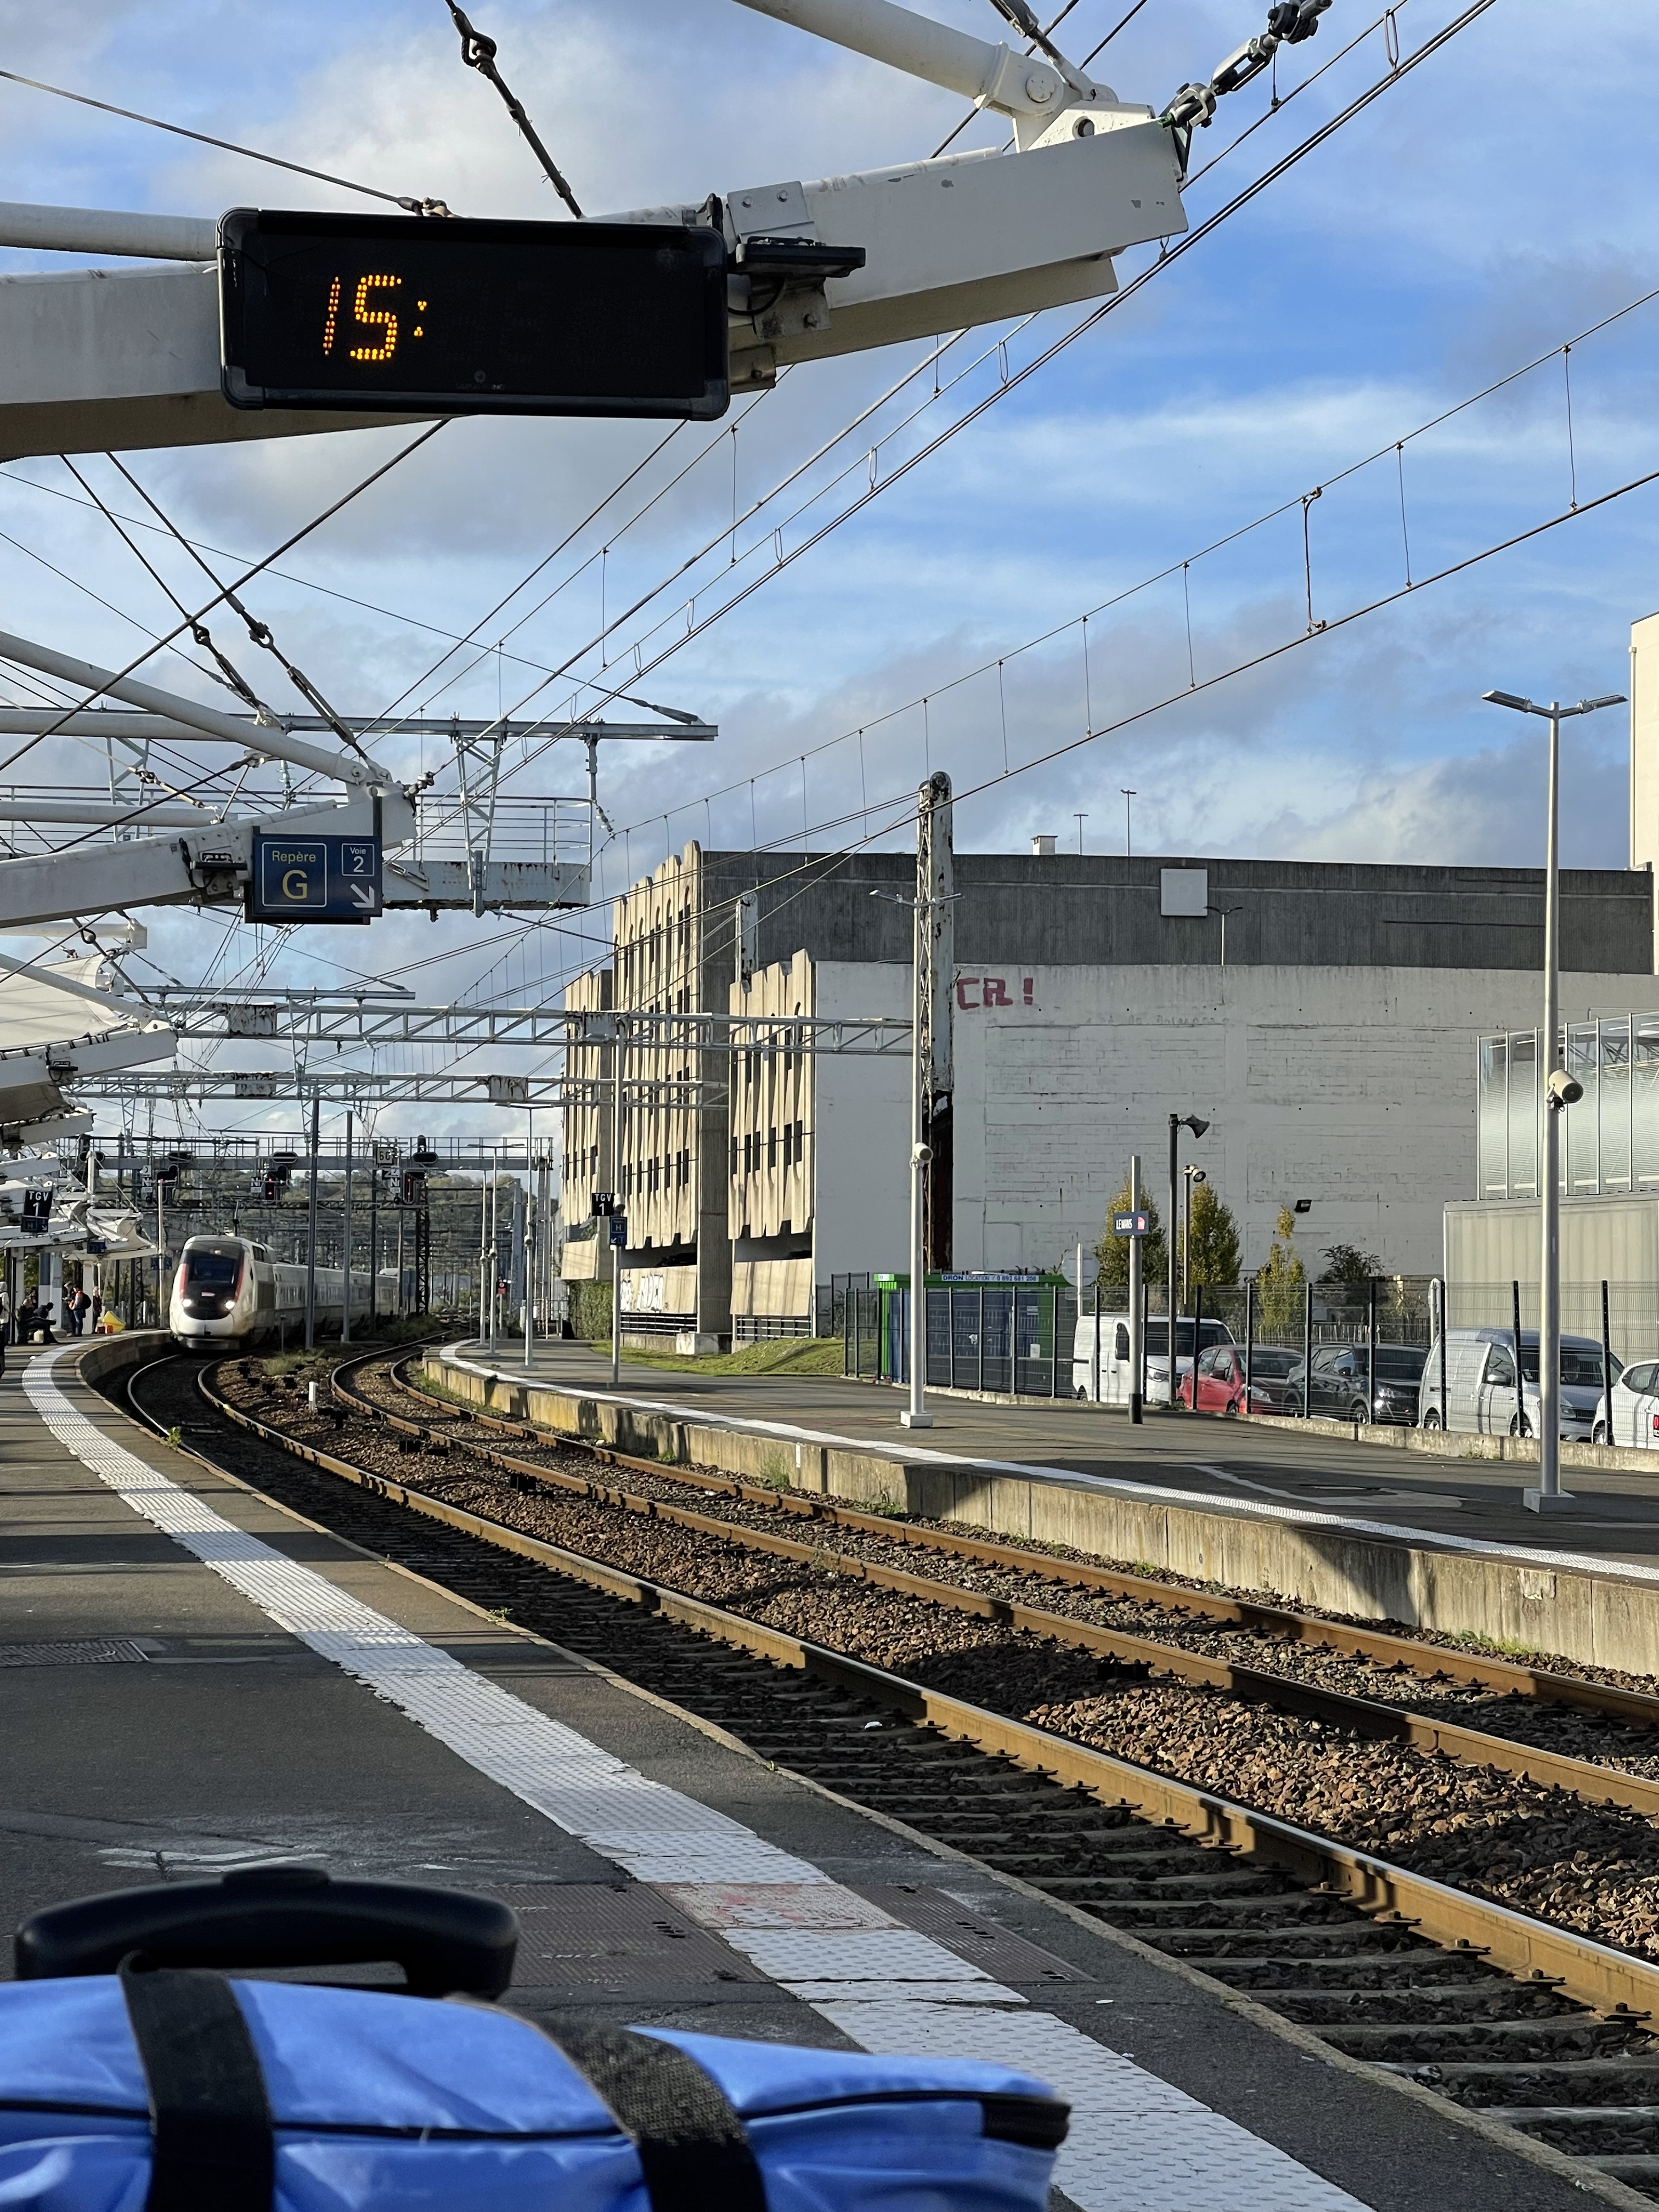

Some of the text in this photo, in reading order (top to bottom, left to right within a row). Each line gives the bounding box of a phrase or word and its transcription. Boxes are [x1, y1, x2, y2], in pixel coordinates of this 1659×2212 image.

[272, 850, 316, 864] Repère
[349, 847, 366, 855] Voie
[353, 856, 364, 873] 2
[282, 870, 308, 900] G
[29, 1190, 49, 1201] TGV
[594, 1193, 612, 1201] TGV
[33, 1202, 39, 1216] 1
[599, 1203, 605, 1216] 1
[1116, 1218, 1121, 1230] LE
